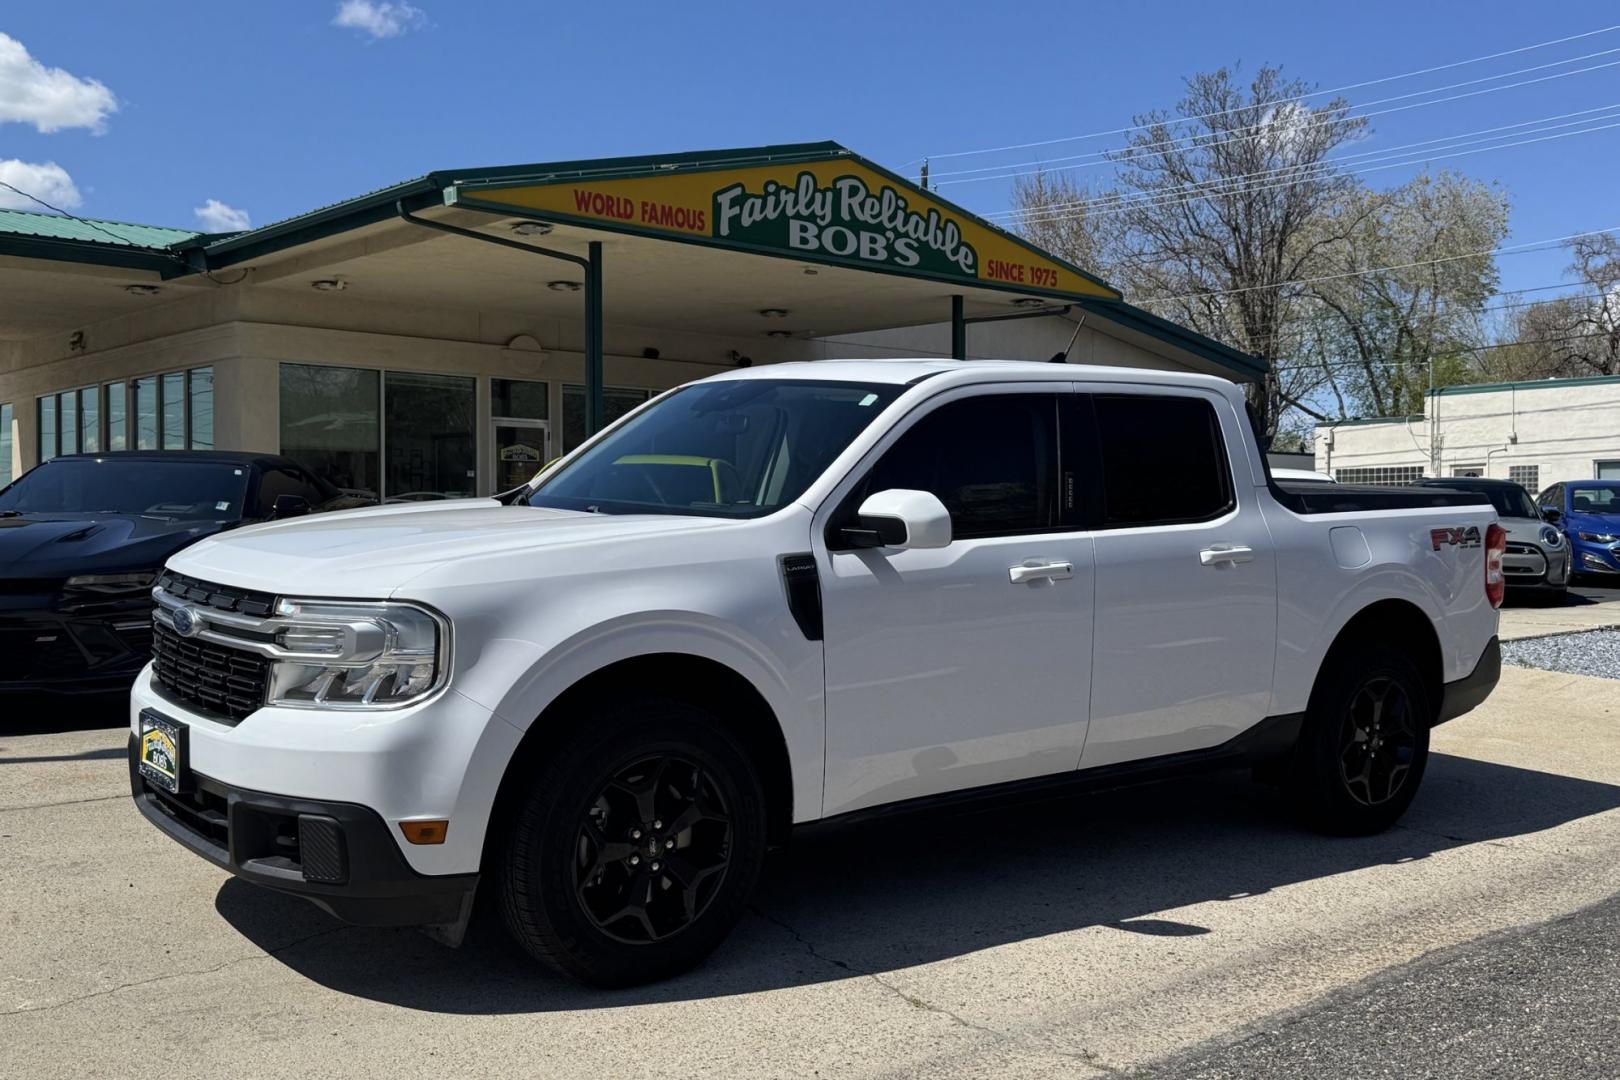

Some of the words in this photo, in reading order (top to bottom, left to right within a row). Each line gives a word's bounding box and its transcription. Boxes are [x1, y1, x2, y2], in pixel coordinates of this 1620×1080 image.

[574, 189, 634, 219] WORLD
[641, 201, 705, 231] FAMOUS
[717, 174, 833, 236] Fairly
[836, 178, 976, 274] Reliable
[789, 218, 920, 266] BOB'S
[987, 259, 1024, 282] SINCE
[1030, 266, 1057, 287] 1975
[1431, 526, 1481, 551] FX4
